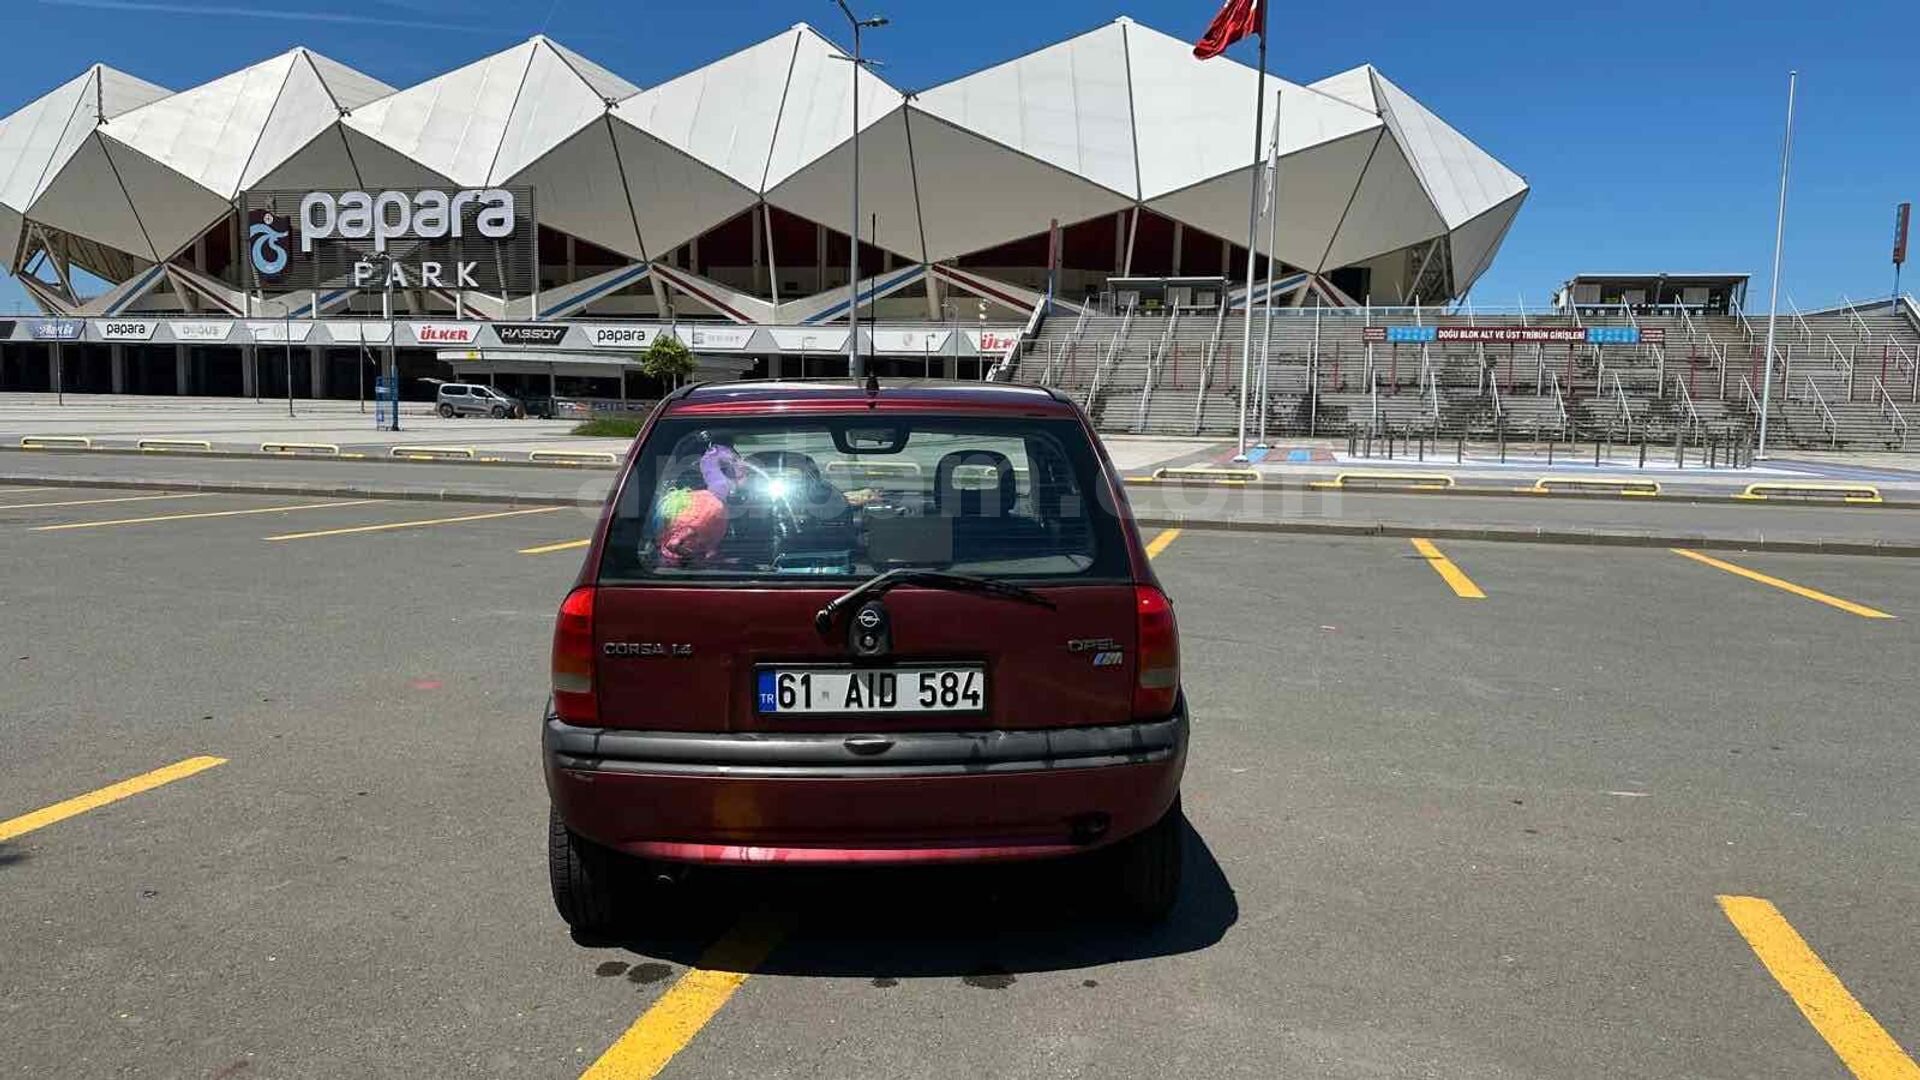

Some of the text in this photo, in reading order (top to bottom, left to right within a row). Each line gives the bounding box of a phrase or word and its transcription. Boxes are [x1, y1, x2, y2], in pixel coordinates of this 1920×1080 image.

[301, 190, 514, 252] papara
[354, 261, 479, 288] PARK
[106, 322, 146, 336] papara
[420, 325, 469, 341] ÜLKER
[500, 328, 560, 340] HASSOY
[597, 328, 646, 343] papara
[1480, 330, 1495, 339] ALT
[1496, 330, 1505, 339] VE
[603, 642, 664, 655] CORSA
[760, 671, 980, 709] TR 61 AID 584
